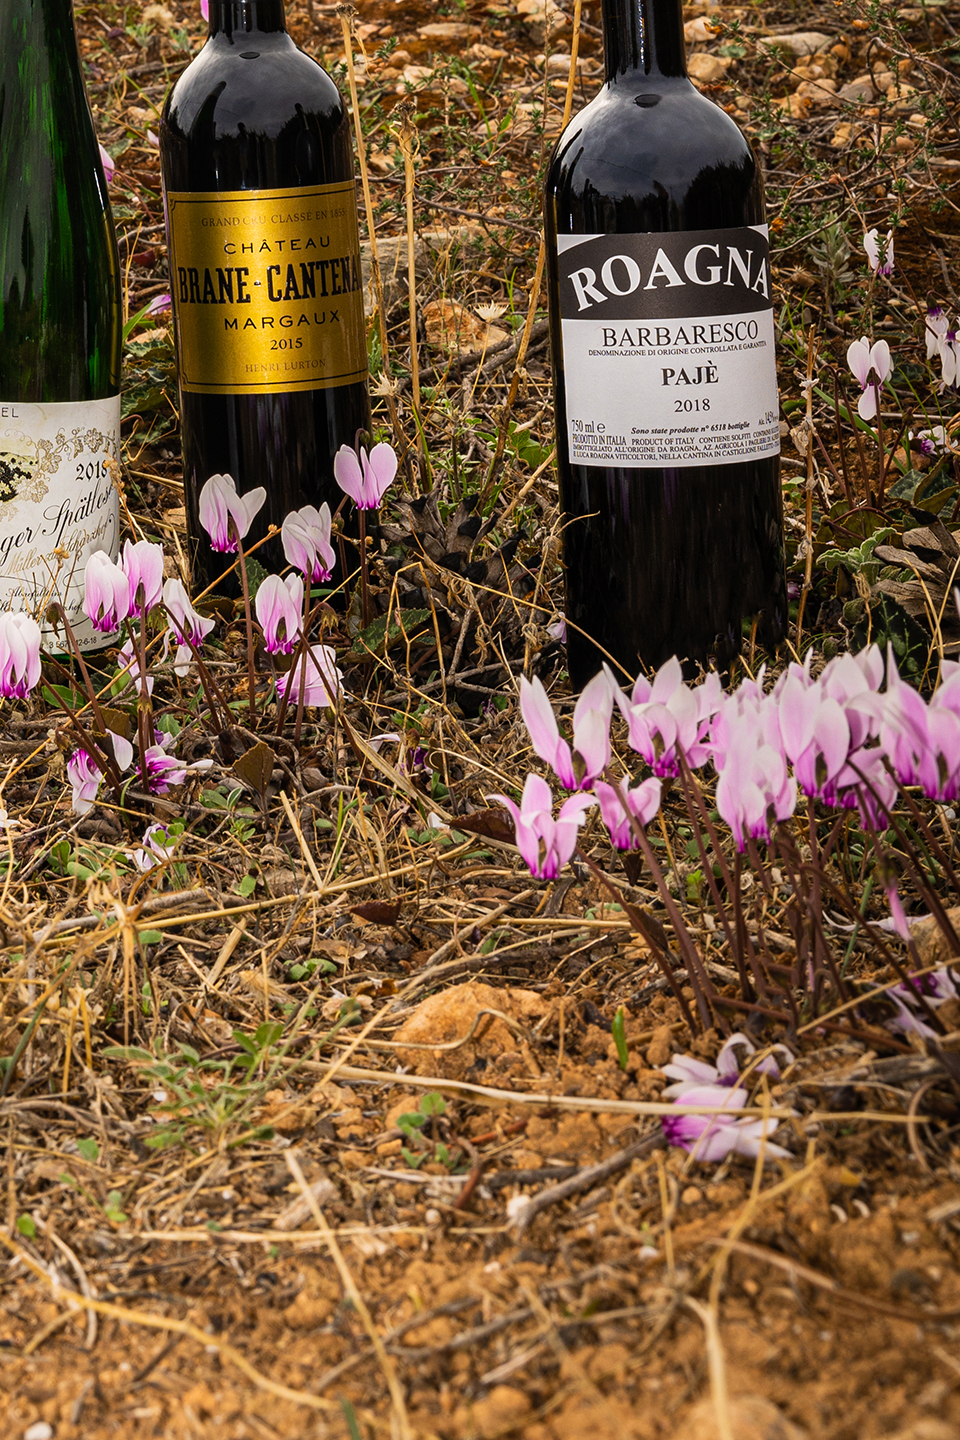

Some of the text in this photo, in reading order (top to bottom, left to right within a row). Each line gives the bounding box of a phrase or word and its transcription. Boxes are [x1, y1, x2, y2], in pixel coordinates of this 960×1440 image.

[201, 216, 240, 228] GRAND
[242, 215, 267, 225] CRU
[315, 209, 328, 221] EN
[223, 235, 330, 255] CHÂTEAU
[567, 243, 770, 312] ROAGNA
[224, 309, 340, 331] MARGAUX
[601, 319, 759, 348] BARBARESCO
[270, 337, 303, 351] 2015
[588, 349, 646, 357] DENOMINAZIONE
[657, 348, 689, 356] ORIGINE
[689, 344, 738, 355] CONTROLLATA
[245, 358, 326, 373] HENRI LURTON
[660, 360, 719, 387] PAJÈ
[673, 398, 711, 413] 2018
[571, 419, 583, 432] 750
[584, 420, 595, 433] ml
[630, 427, 649, 435] Sono
[650, 427, 668, 435] state
[668, 425, 699, 435] prodotte
[710, 423, 727, 432] 6518
[606, 435, 627, 446] ITALIA
[631, 438, 664, 446] PRODUCT
[675, 437, 695, 445] ITALY
[699, 434, 730, 444] CONTIENE
[714, 441, 744, 451] AGRICOLA
[590, 452, 614, 460] ROAGNA
[682, 451, 713, 460] CANTINA
[721, 446, 757, 457] CASTIGLIONE
[75, 459, 108, 481] 2018
